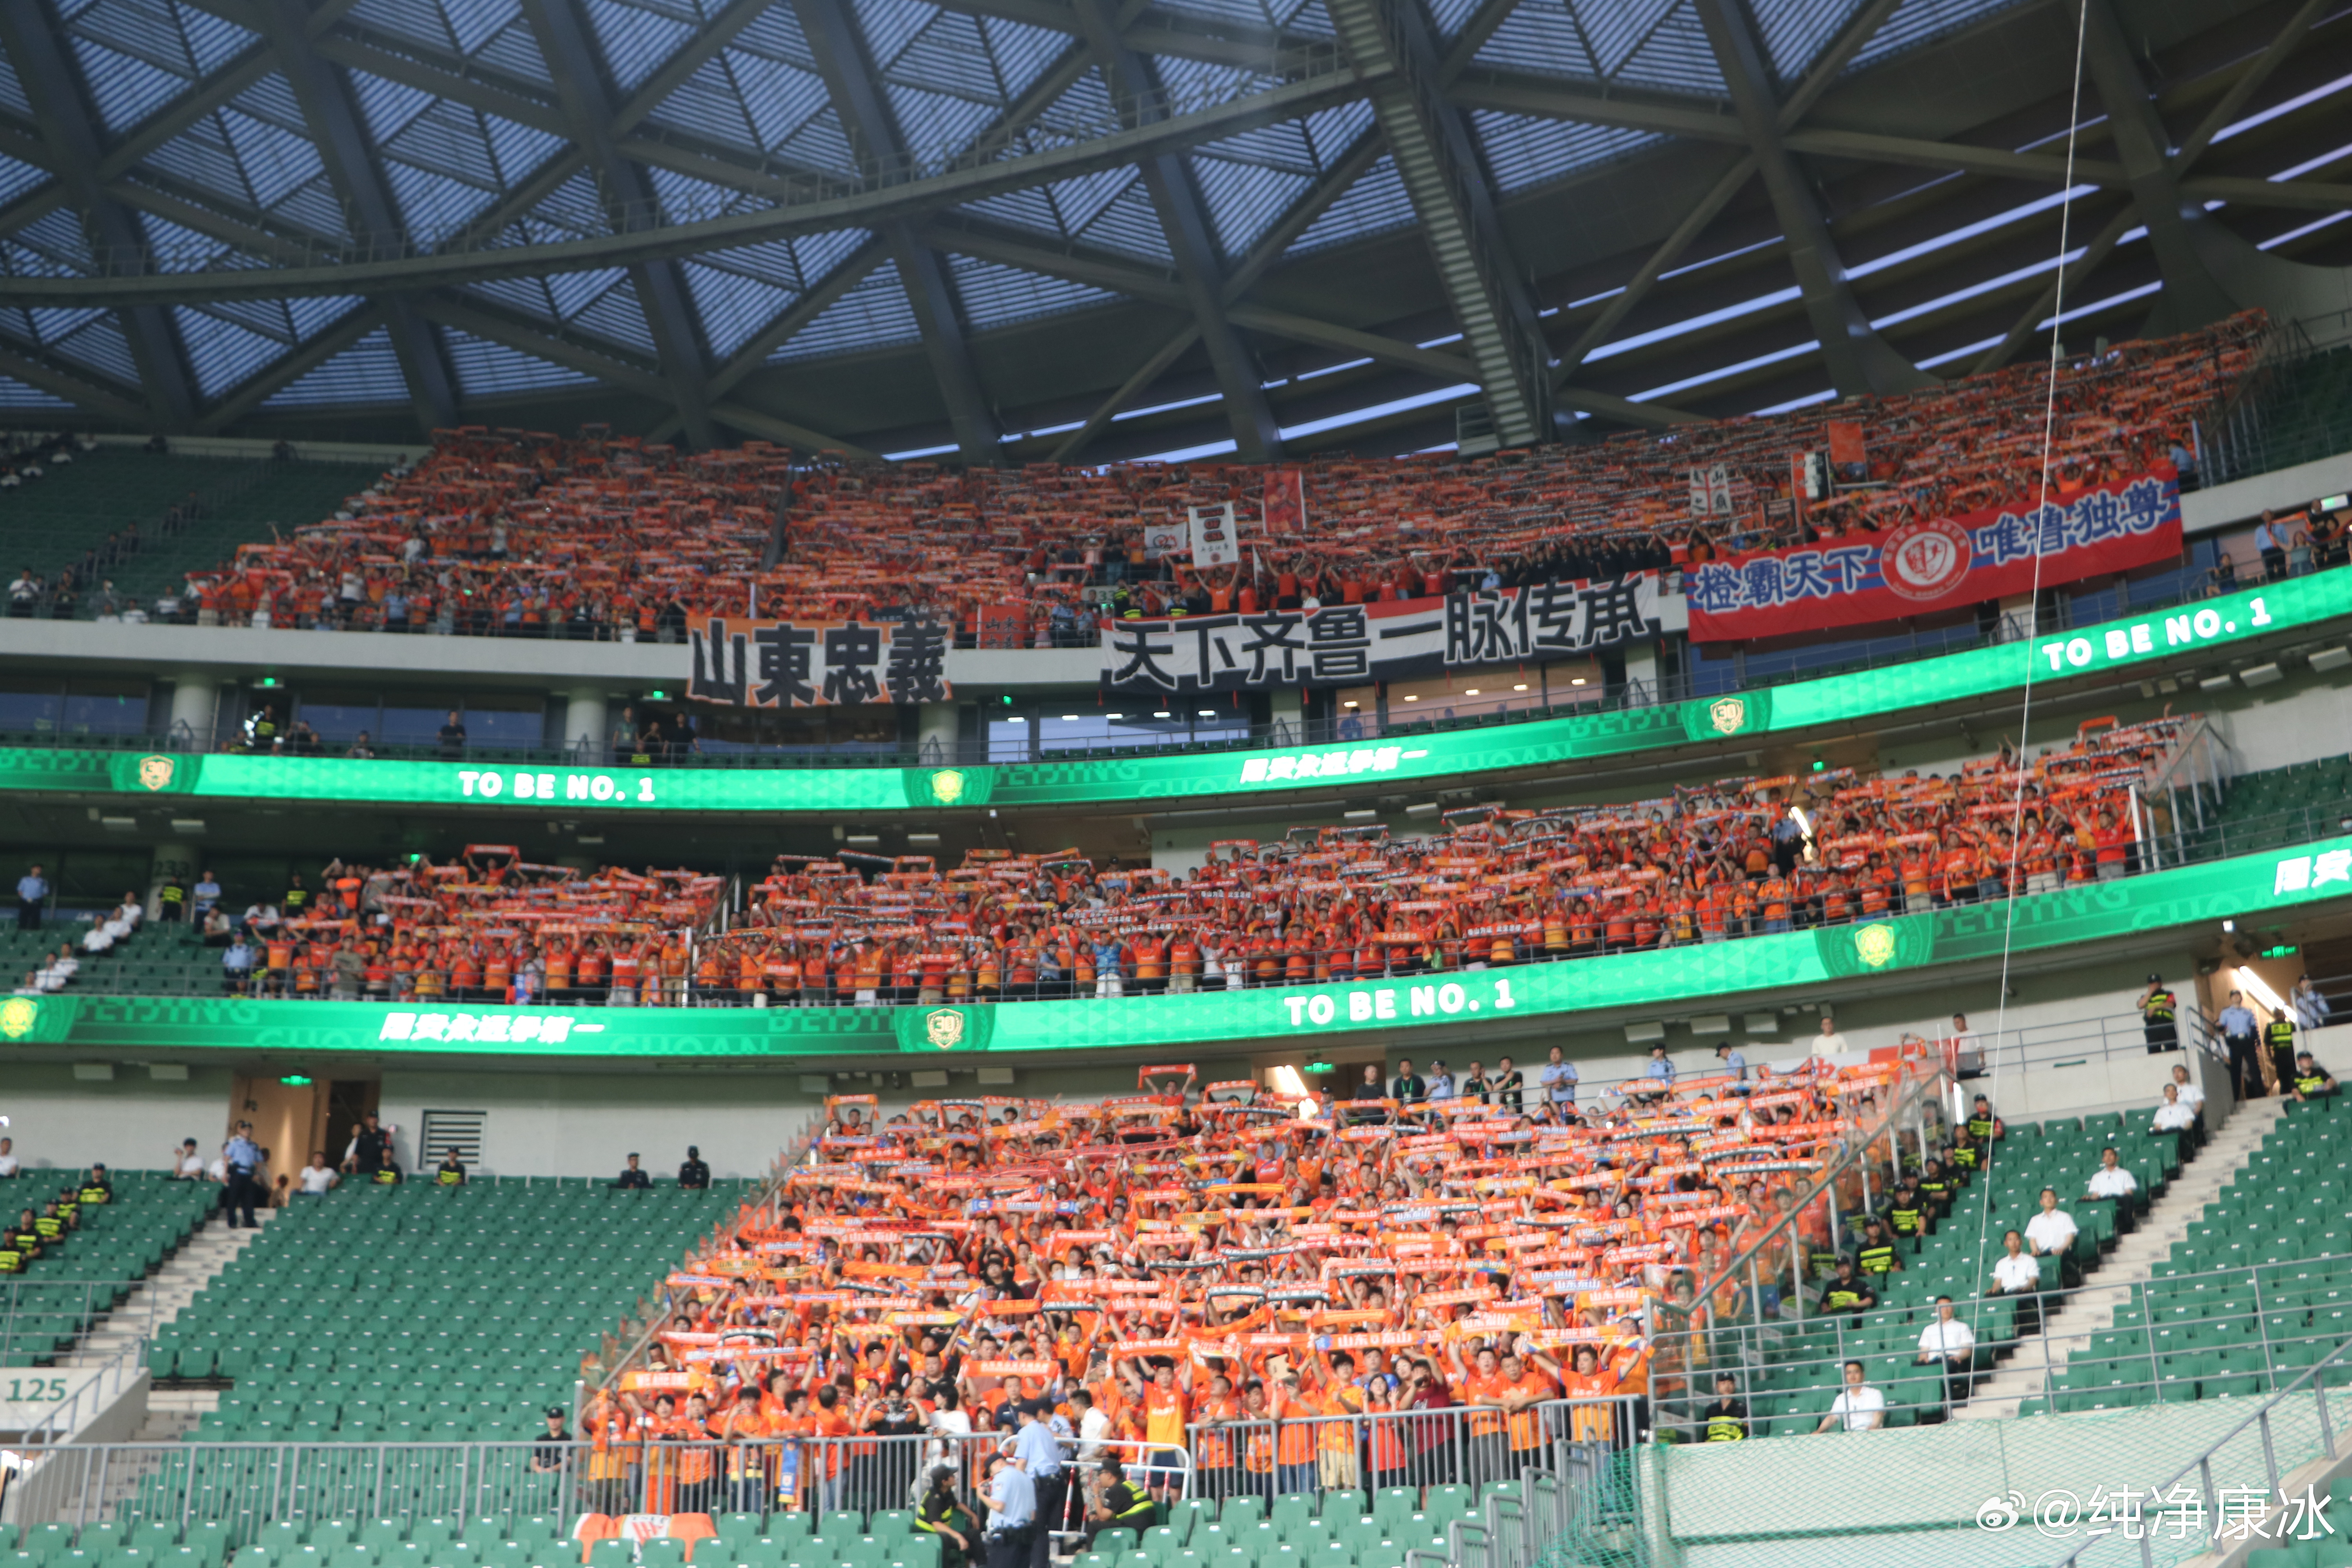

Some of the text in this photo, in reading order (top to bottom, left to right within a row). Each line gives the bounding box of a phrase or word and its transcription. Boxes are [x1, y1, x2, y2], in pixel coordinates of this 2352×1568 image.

[1695, 545, 1873, 613] 橙霸天下
[1977, 481, 2171, 563] 唯鲁独尊
[1112, 573, 1649, 687] 天下齐鲁一脉传承
[2042, 597, 2271, 671] TO BE NO. 1
[690, 618, 948, 706] 山東忠義
[1717, 704, 1736, 720] 30
[459, 771, 655, 802] TO BE NO. 1
[1284, 978, 1514, 1026] TO BE NO. 1
[935, 1016, 955, 1032] 30
[1338, 1332, 1412, 1346] 山东泰山
[5, 1379, 67, 1401] 125
